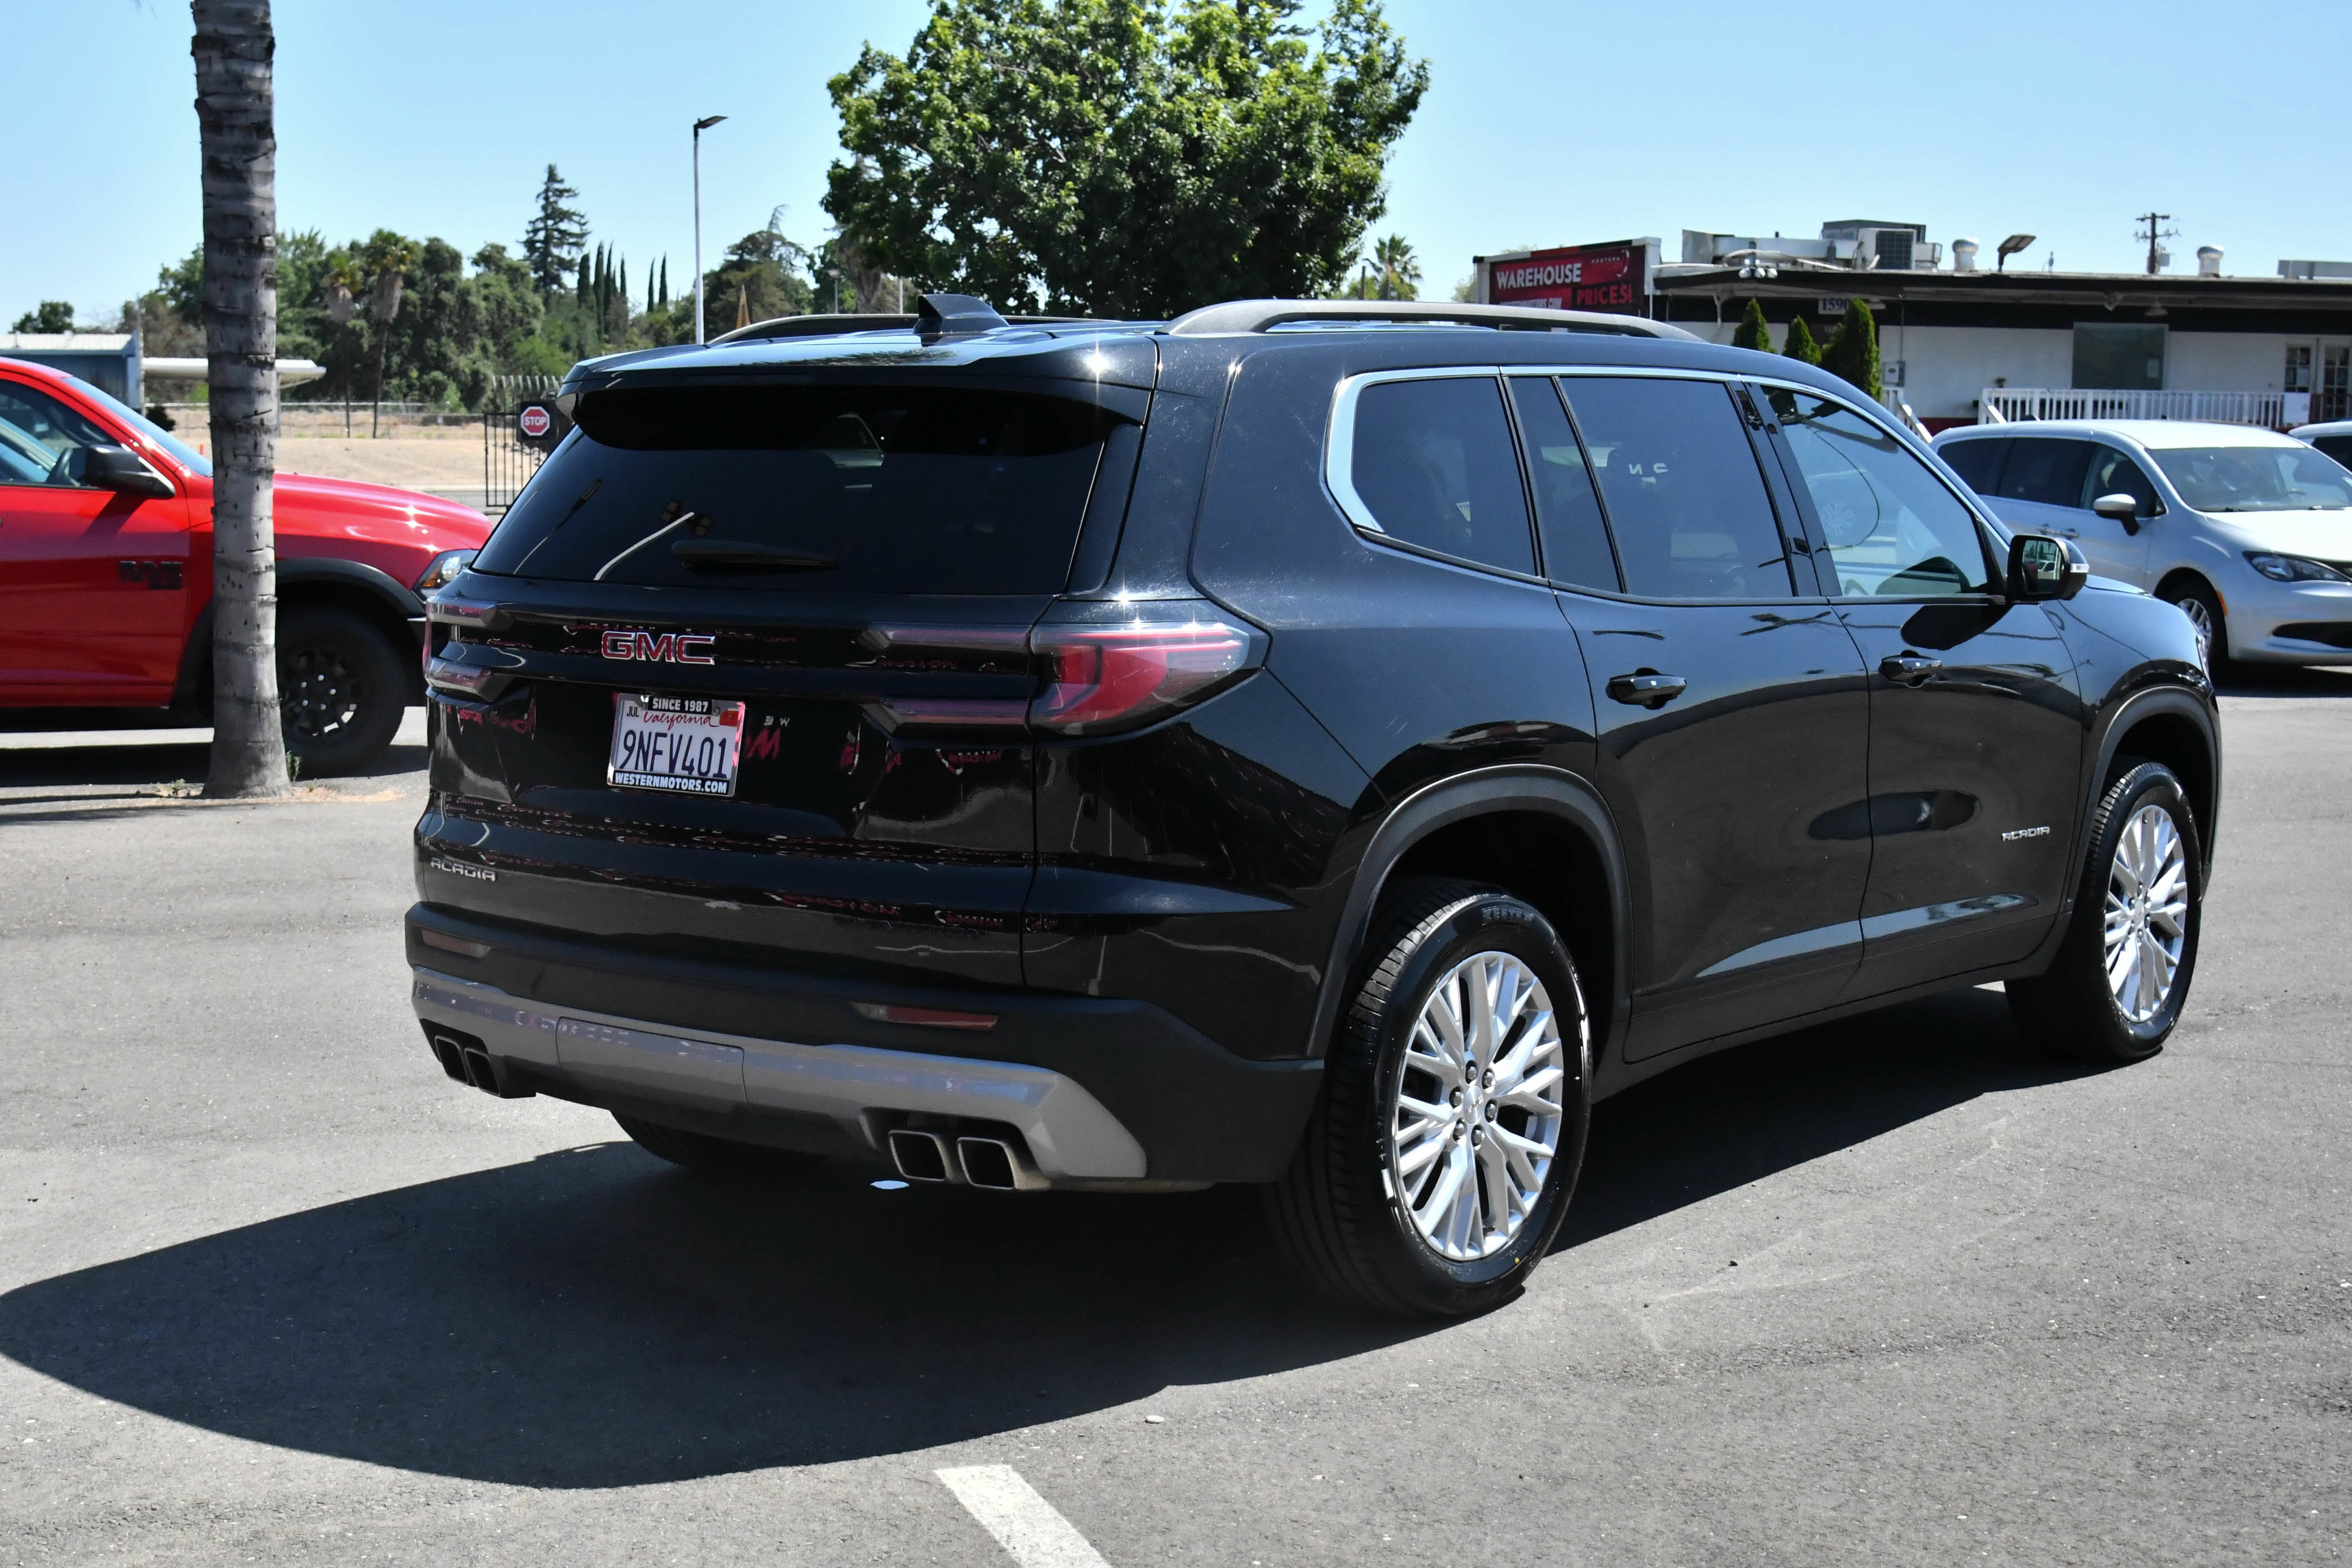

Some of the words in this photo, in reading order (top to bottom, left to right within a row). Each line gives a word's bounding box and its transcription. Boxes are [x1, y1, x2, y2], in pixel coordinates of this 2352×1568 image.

[1496, 263, 1582, 290] WAREHOUSE
[1577, 284, 1632, 305] PRICES!
[524, 416, 547, 426] STOP
[602, 631, 715, 665] GMC
[626, 706, 640, 718] JUL
[652, 697, 681, 711] SINCE
[684, 700, 709, 712] 1987
[644, 710, 719, 731] California
[620, 729, 727, 779] 9NFV401
[615, 772, 727, 794] WESTERNMOTORS.COM
[2002, 826, 2050, 841] ACADIA
[431, 857, 496, 882] ACADIA
